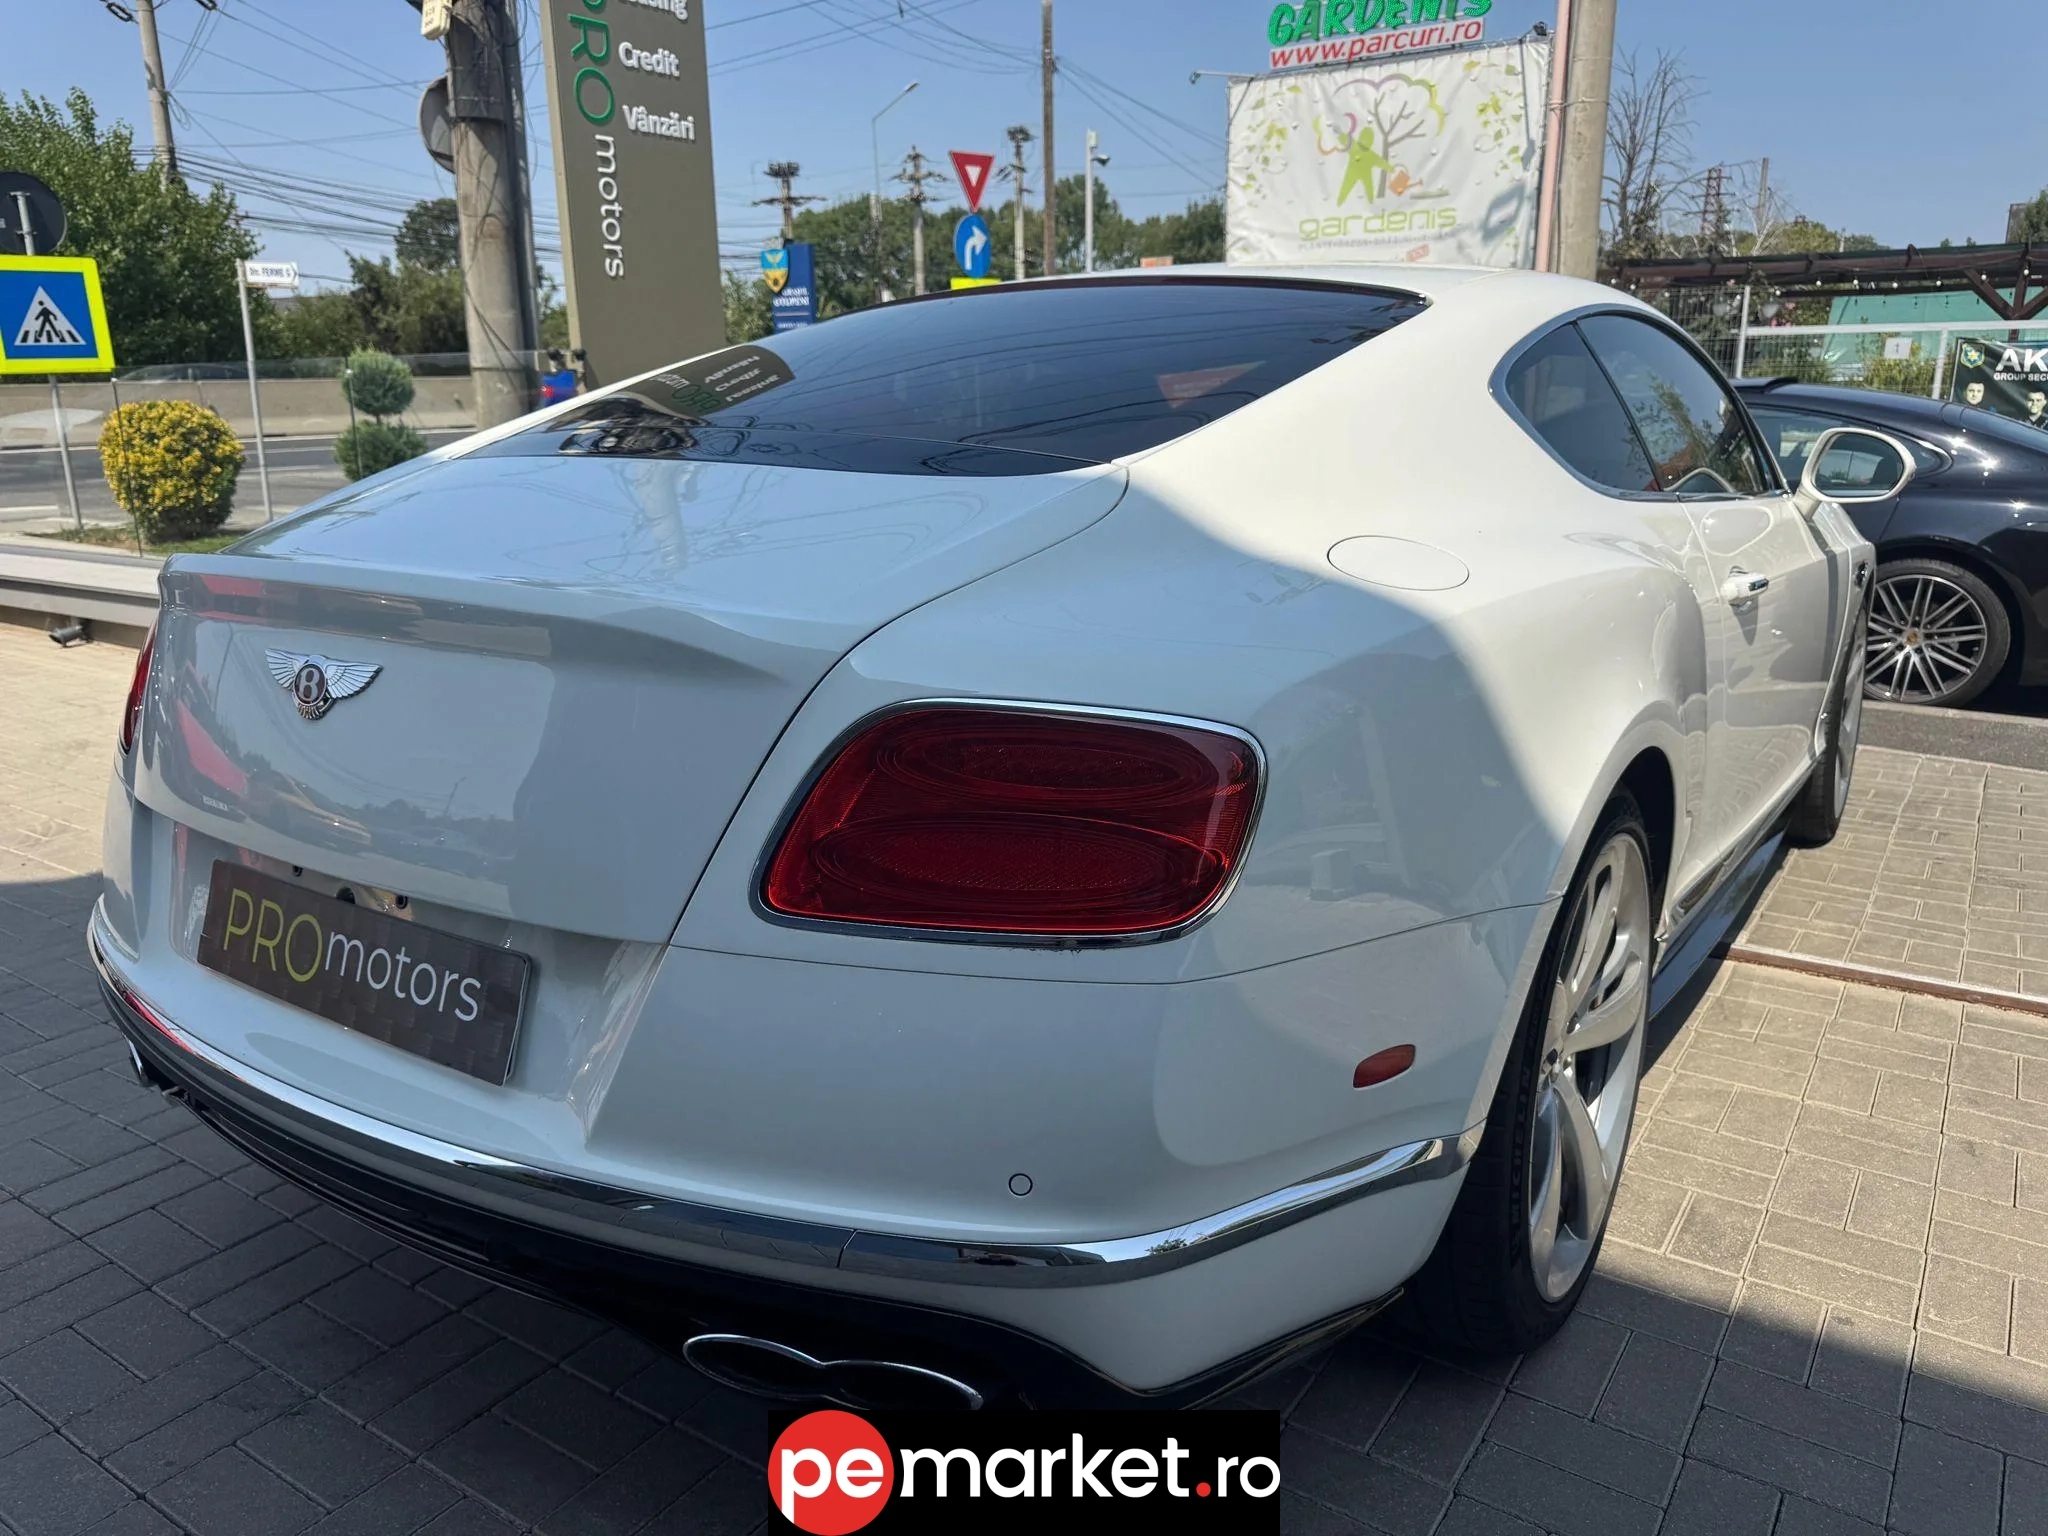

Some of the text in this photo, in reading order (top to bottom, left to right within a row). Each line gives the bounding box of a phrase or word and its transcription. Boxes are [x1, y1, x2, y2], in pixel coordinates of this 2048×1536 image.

[618, 41, 680, 77] Credit
[1271, 20, 1481, 68] www.parcuri.ro
[622, 104, 696, 140] Vânzări
[1299, 207, 1457, 242] gardenis
[1993, 372, 2026, 381] GROUP
[223, 889, 481, 1021] PROmotors
